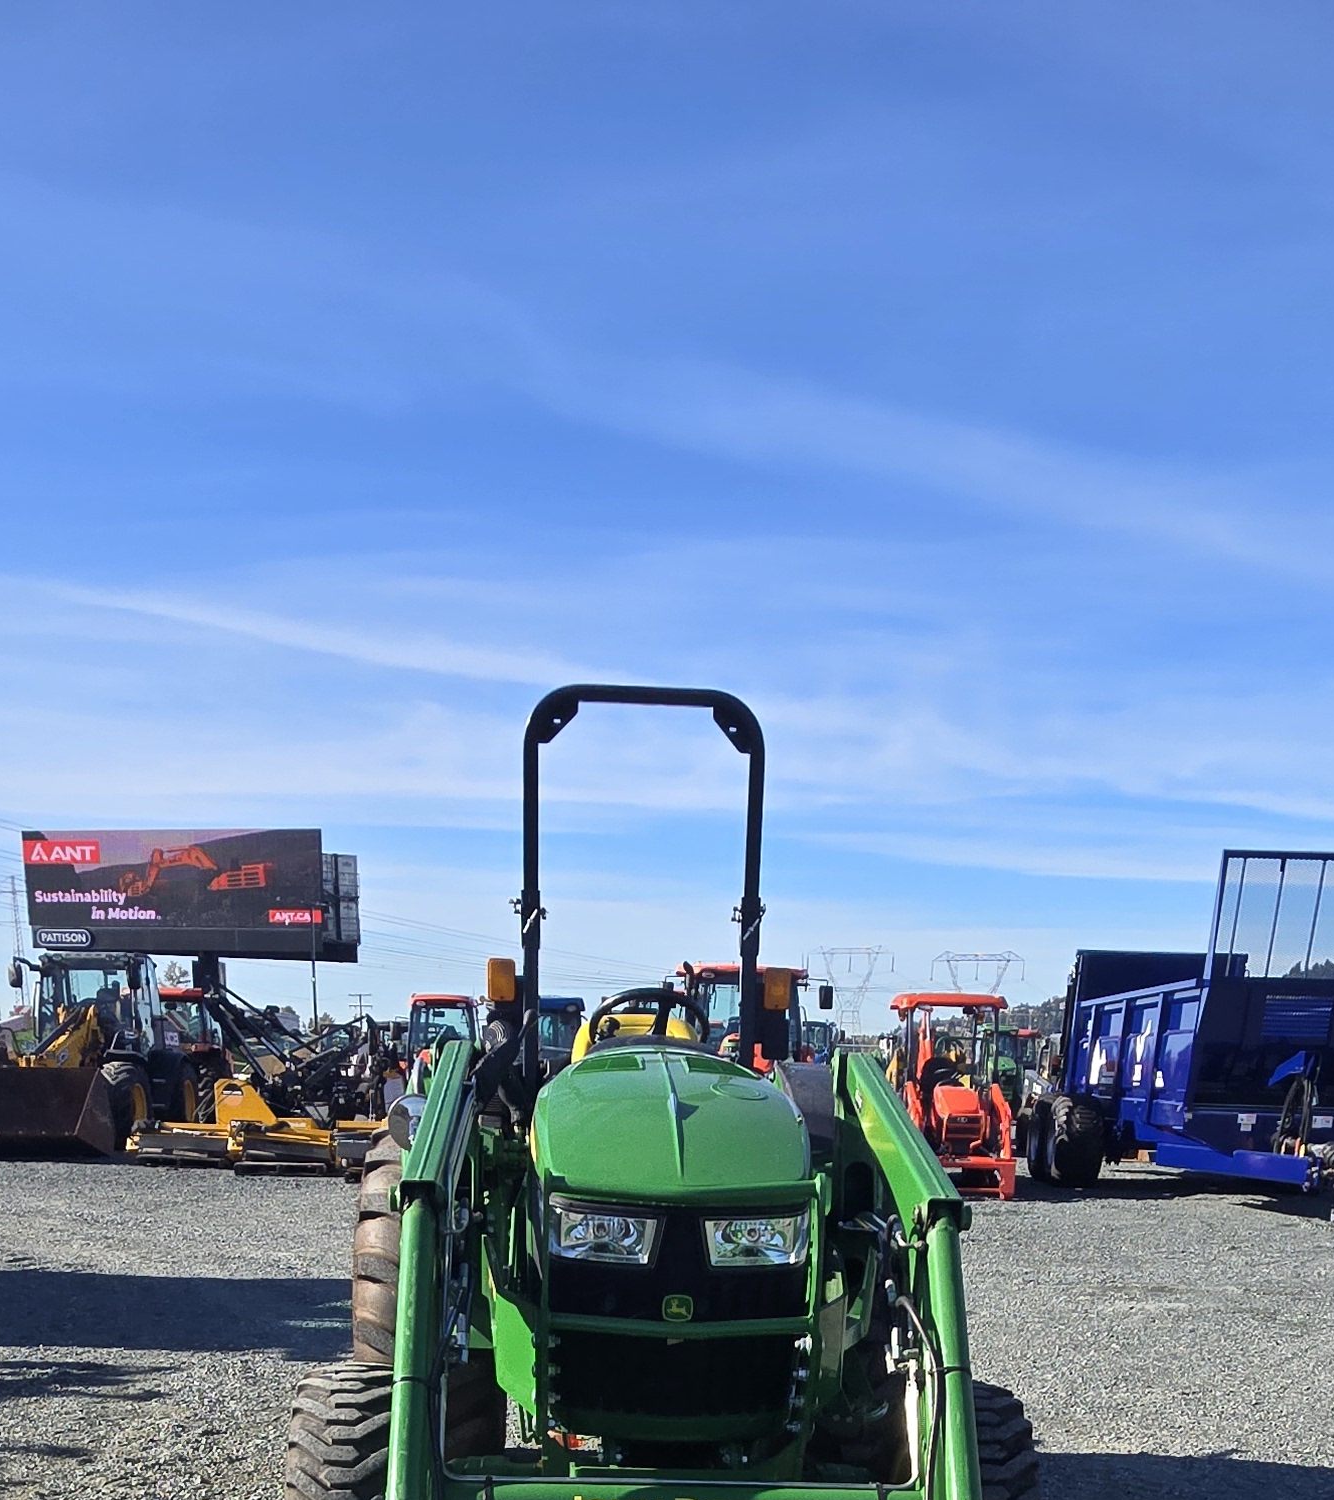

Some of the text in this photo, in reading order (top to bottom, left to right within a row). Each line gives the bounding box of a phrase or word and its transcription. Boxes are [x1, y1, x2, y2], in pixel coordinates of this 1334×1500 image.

[49, 845, 97, 861] ANT
[34, 888, 127, 906] Sustainability
[91, 905, 106, 920] in
[274, 912, 312, 922] ANT.CA
[40, 932, 87, 943] PATTISON
